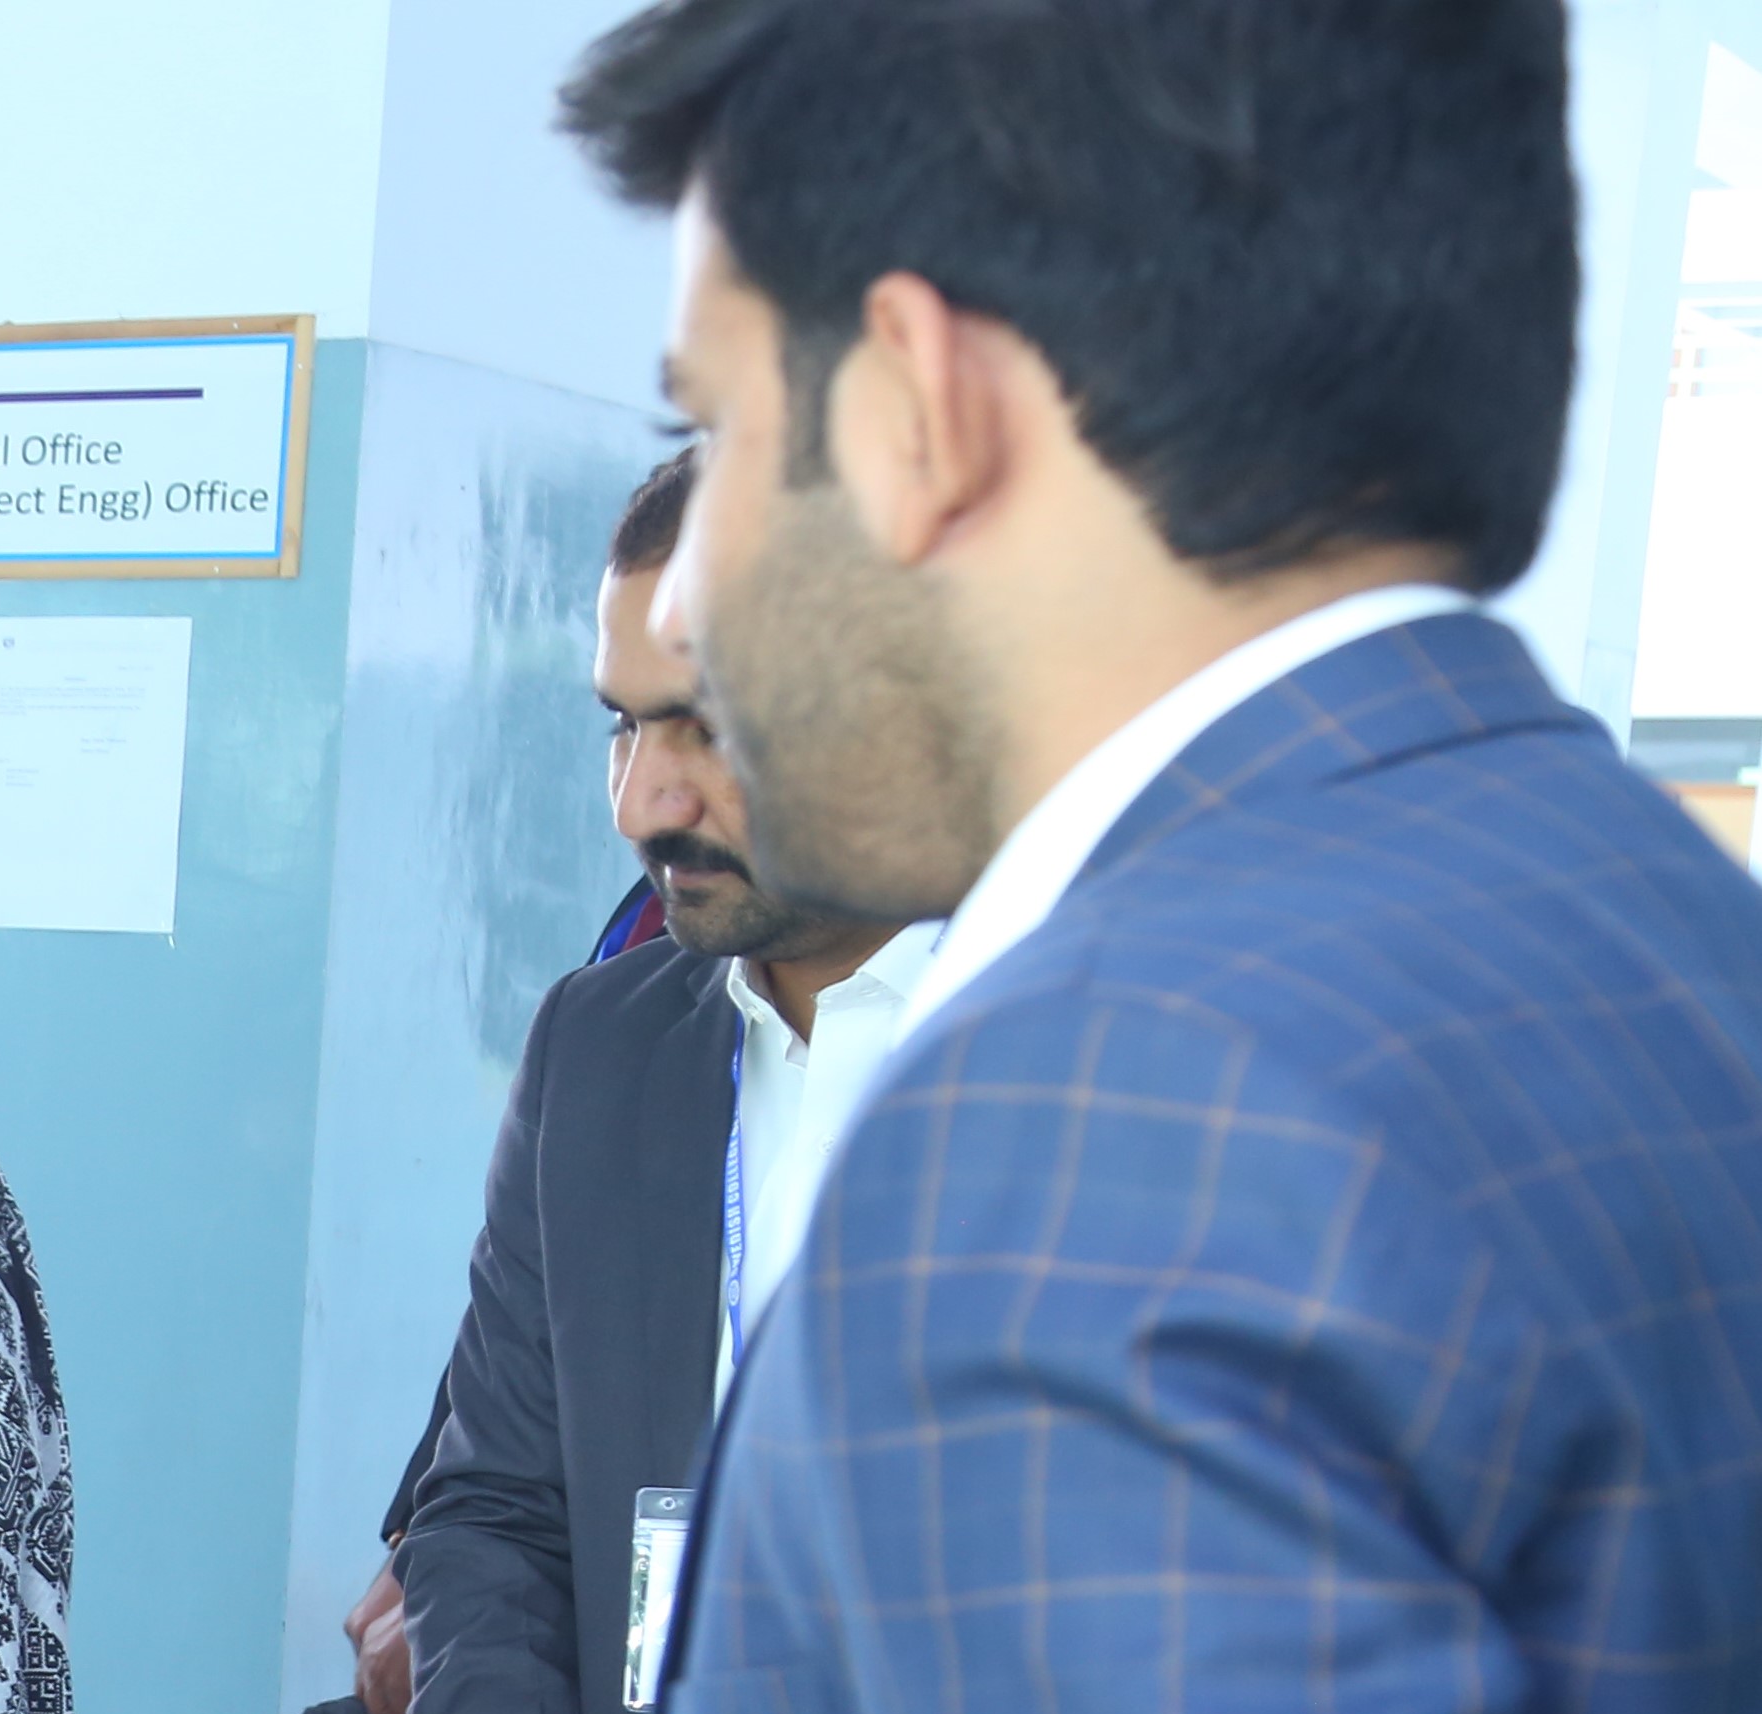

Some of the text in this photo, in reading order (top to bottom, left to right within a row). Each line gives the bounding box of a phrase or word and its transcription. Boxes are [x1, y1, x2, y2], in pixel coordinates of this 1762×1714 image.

[21, 433, 123, 466] Office
[58, 481, 153, 521] Engg)
[165, 480, 270, 513] Office
[727, 1141, 741, 1204] COLLEGE
